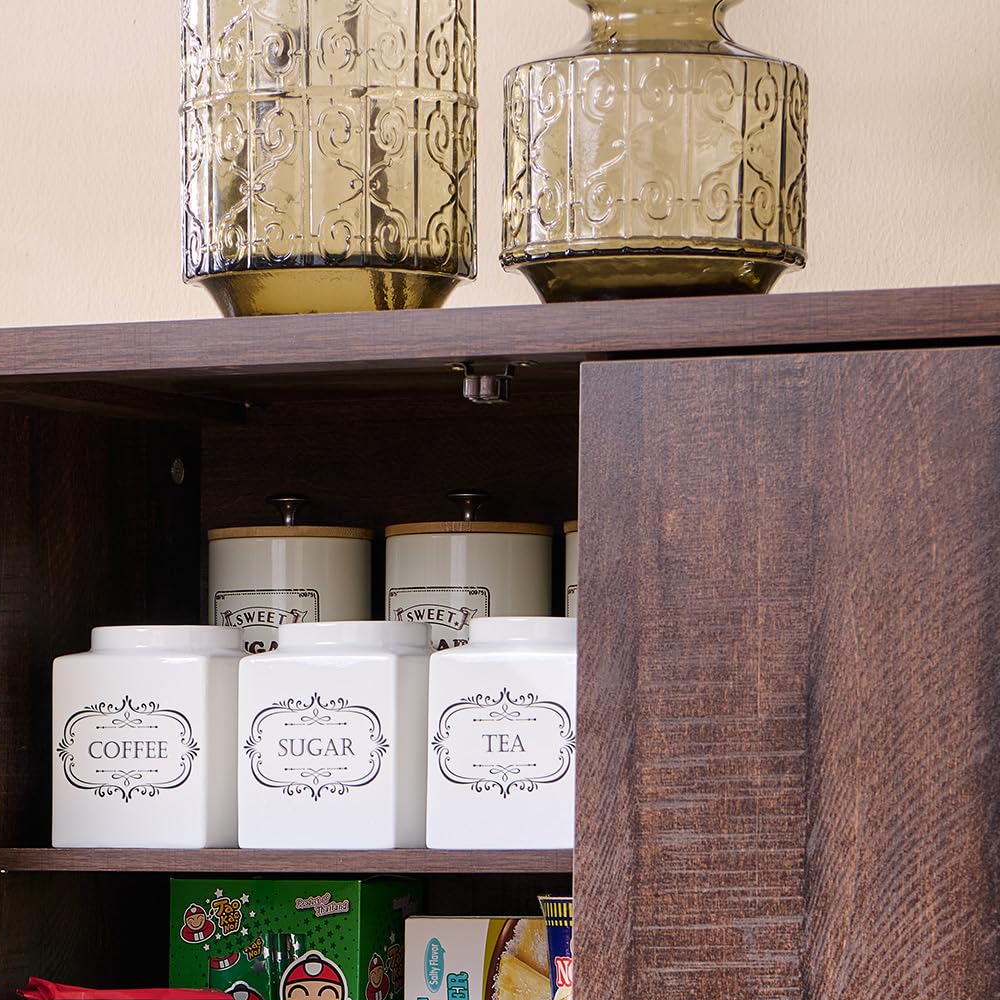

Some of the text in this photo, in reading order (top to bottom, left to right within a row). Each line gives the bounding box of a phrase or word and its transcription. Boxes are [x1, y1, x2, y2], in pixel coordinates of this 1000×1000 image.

[236, 611, 287, 625] SWEET
[406, 609, 457, 623] SWEET
[87, 740, 169, 760] COFFEE
[276, 737, 356, 758] SUGAR
[482, 733, 526, 754] TEA
[213, 899, 240, 916] Tao
[429, 943, 441, 986] Salty Flavor
